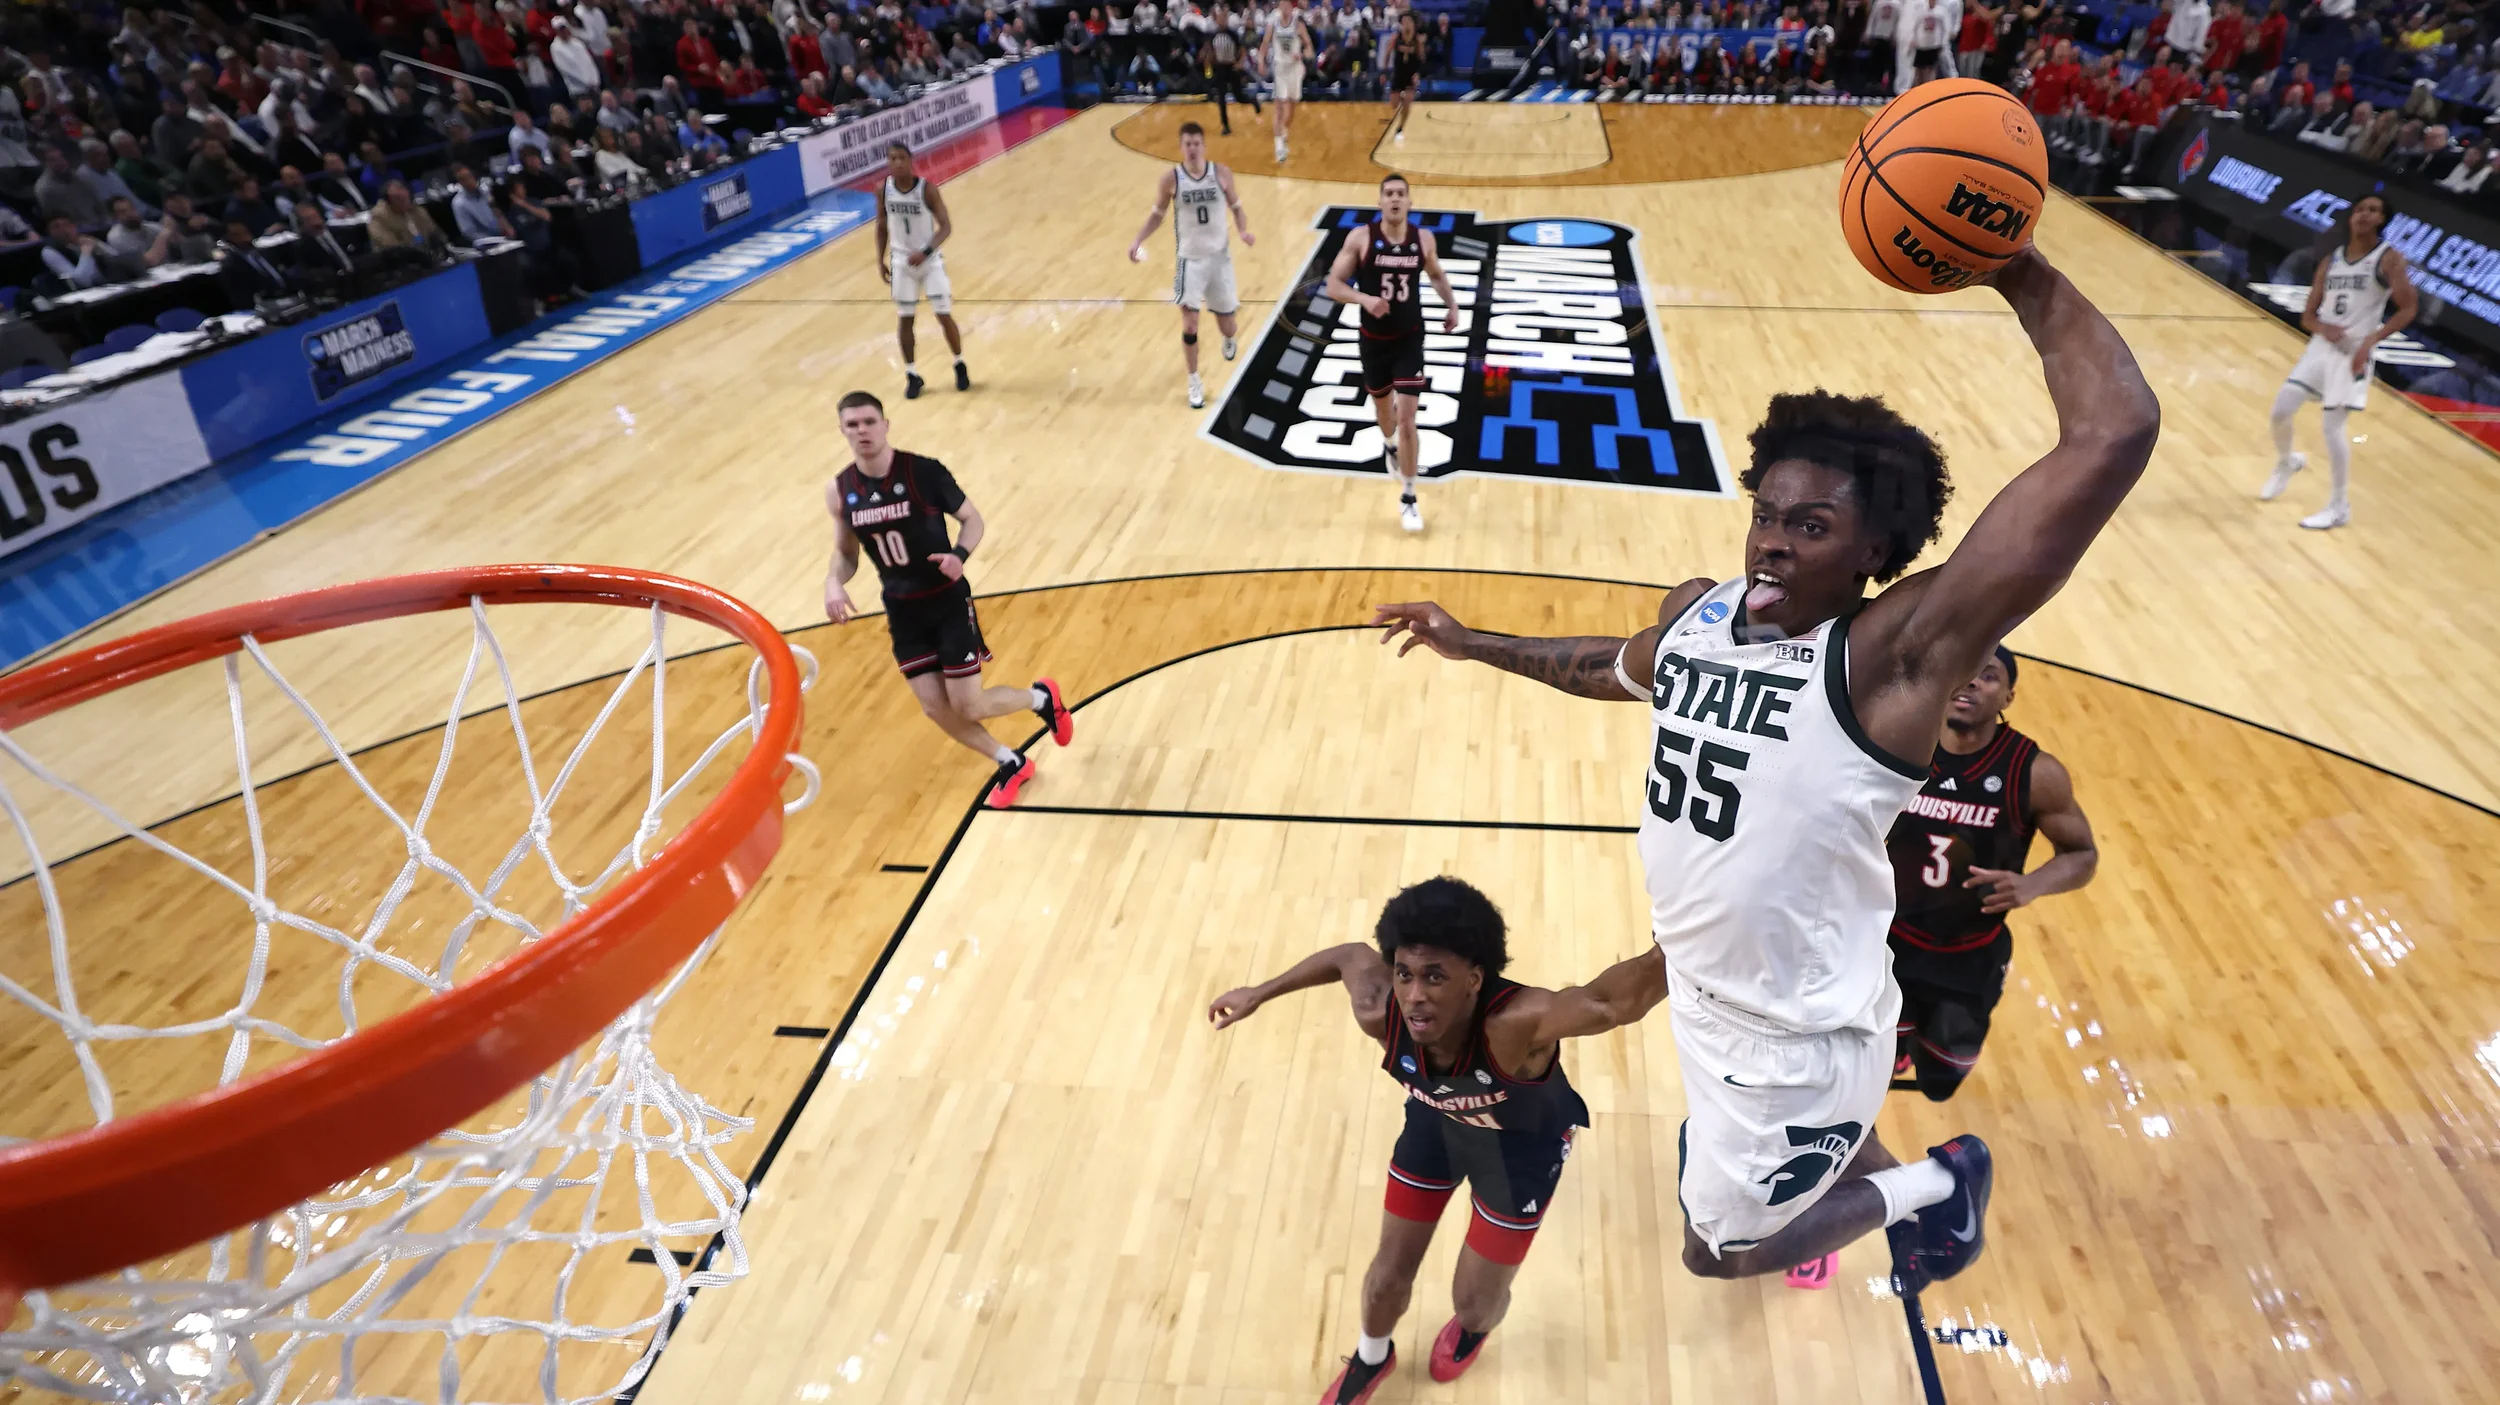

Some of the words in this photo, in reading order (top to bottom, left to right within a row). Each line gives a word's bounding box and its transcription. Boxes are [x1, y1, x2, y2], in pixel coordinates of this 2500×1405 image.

[1643, 94, 1777, 105] SECOND
[868, 112, 902, 140] ATLANTIC
[708, 178, 738, 201] MARCH
[1182, 187, 1217, 204] STATE
[1963, 174, 1987, 189] BALL
[715, 190, 751, 222] MADNESS
[888, 201, 922, 215] STATE
[1197, 205, 1209, 224] 0
[1946, 183, 2031, 242] NCAA
[2281, 189, 2352, 233] ACC
[668, 231, 817, 282] ROAD
[1374, 254, 1419, 268] LOUISVILLE
[1893, 225, 1975, 287] ilson
[1380, 273, 1410, 302] 53
[1484, 243, 1635, 377] MARCH
[2334, 294, 2350, 316] 6
[321, 316, 383, 357] MARCH
[484, 294, 687, 364] FINAL
[339, 329, 415, 376] MADNESS
[272, 370, 534, 467] FOUR
[851, 500, 911, 527] LOUISVILLE
[871, 530, 910, 567] 10
[1703, 607, 1721, 622] NCAA
[1653, 652, 1808, 742] STATE
[1648, 726, 1751, 842] 55
[1903, 794, 2000, 828] OUISVILLE
[1922, 834, 1954, 888] 3
[1402, 1082, 1509, 1112] LOUISVILLE
